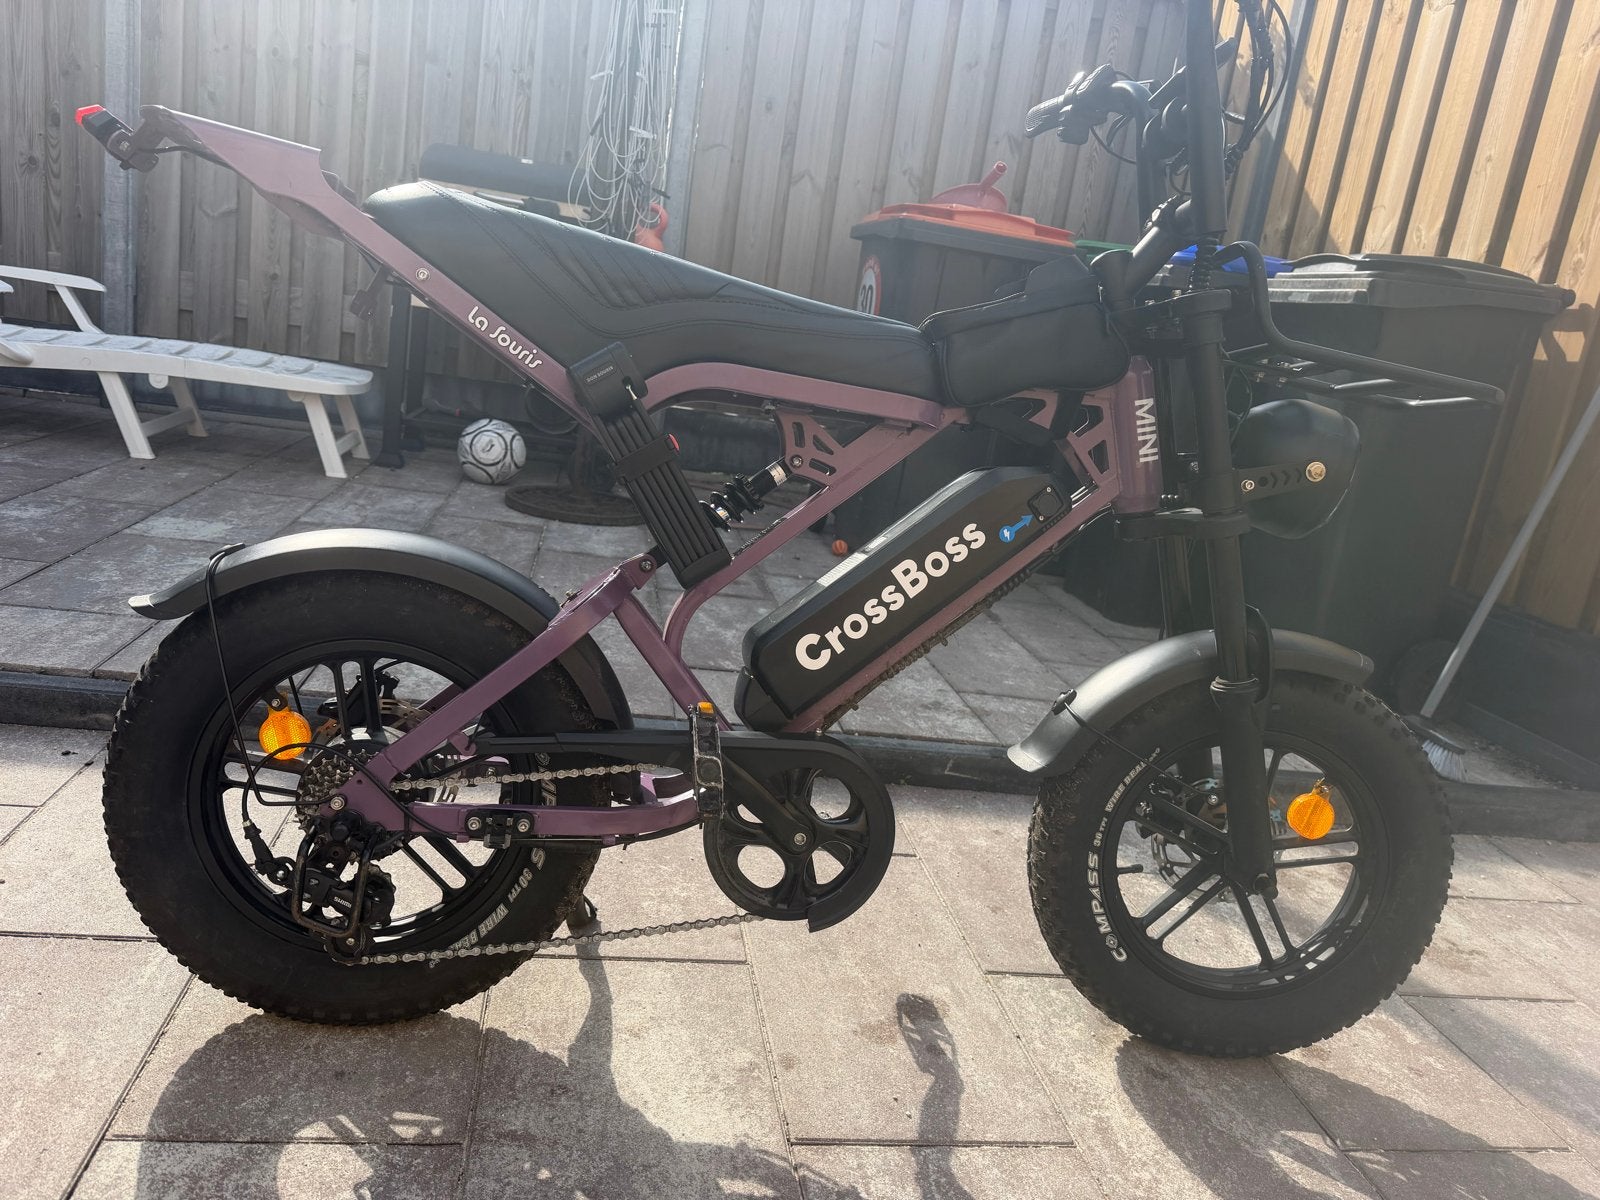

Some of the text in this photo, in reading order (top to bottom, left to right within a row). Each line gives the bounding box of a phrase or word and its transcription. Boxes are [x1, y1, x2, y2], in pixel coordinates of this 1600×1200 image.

[467, 306, 543, 369] La Souris
[1134, 398, 1158, 462] MINI
[795, 523, 986, 671] CrossBoss
[1104, 783, 1125, 812] WIRE
[478, 902, 510, 938] WIRE
